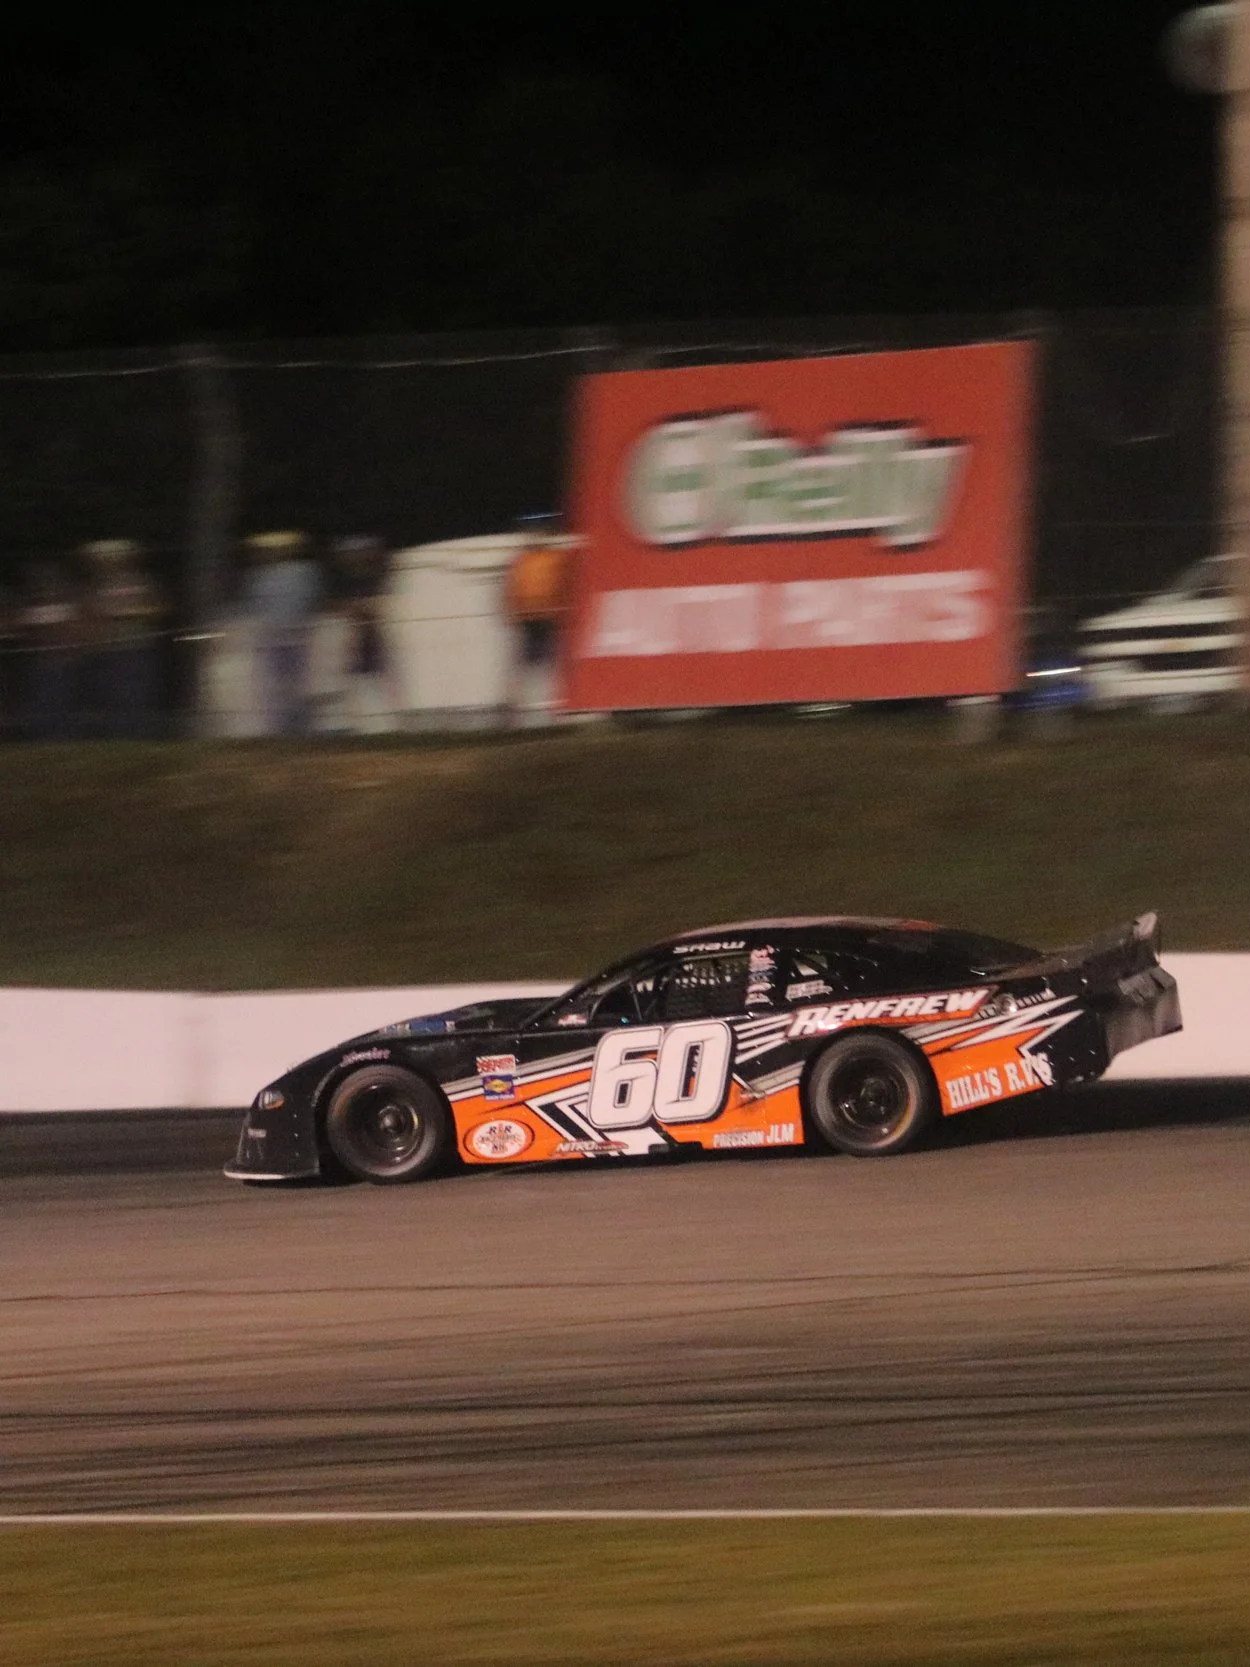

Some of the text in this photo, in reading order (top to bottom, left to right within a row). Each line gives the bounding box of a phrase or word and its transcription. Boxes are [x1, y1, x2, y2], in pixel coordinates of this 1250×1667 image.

[585, 570, 991, 657] AUTO PARTS
[788, 988, 983, 1038] RENFREW
[588, 1021, 732, 1129] 60
